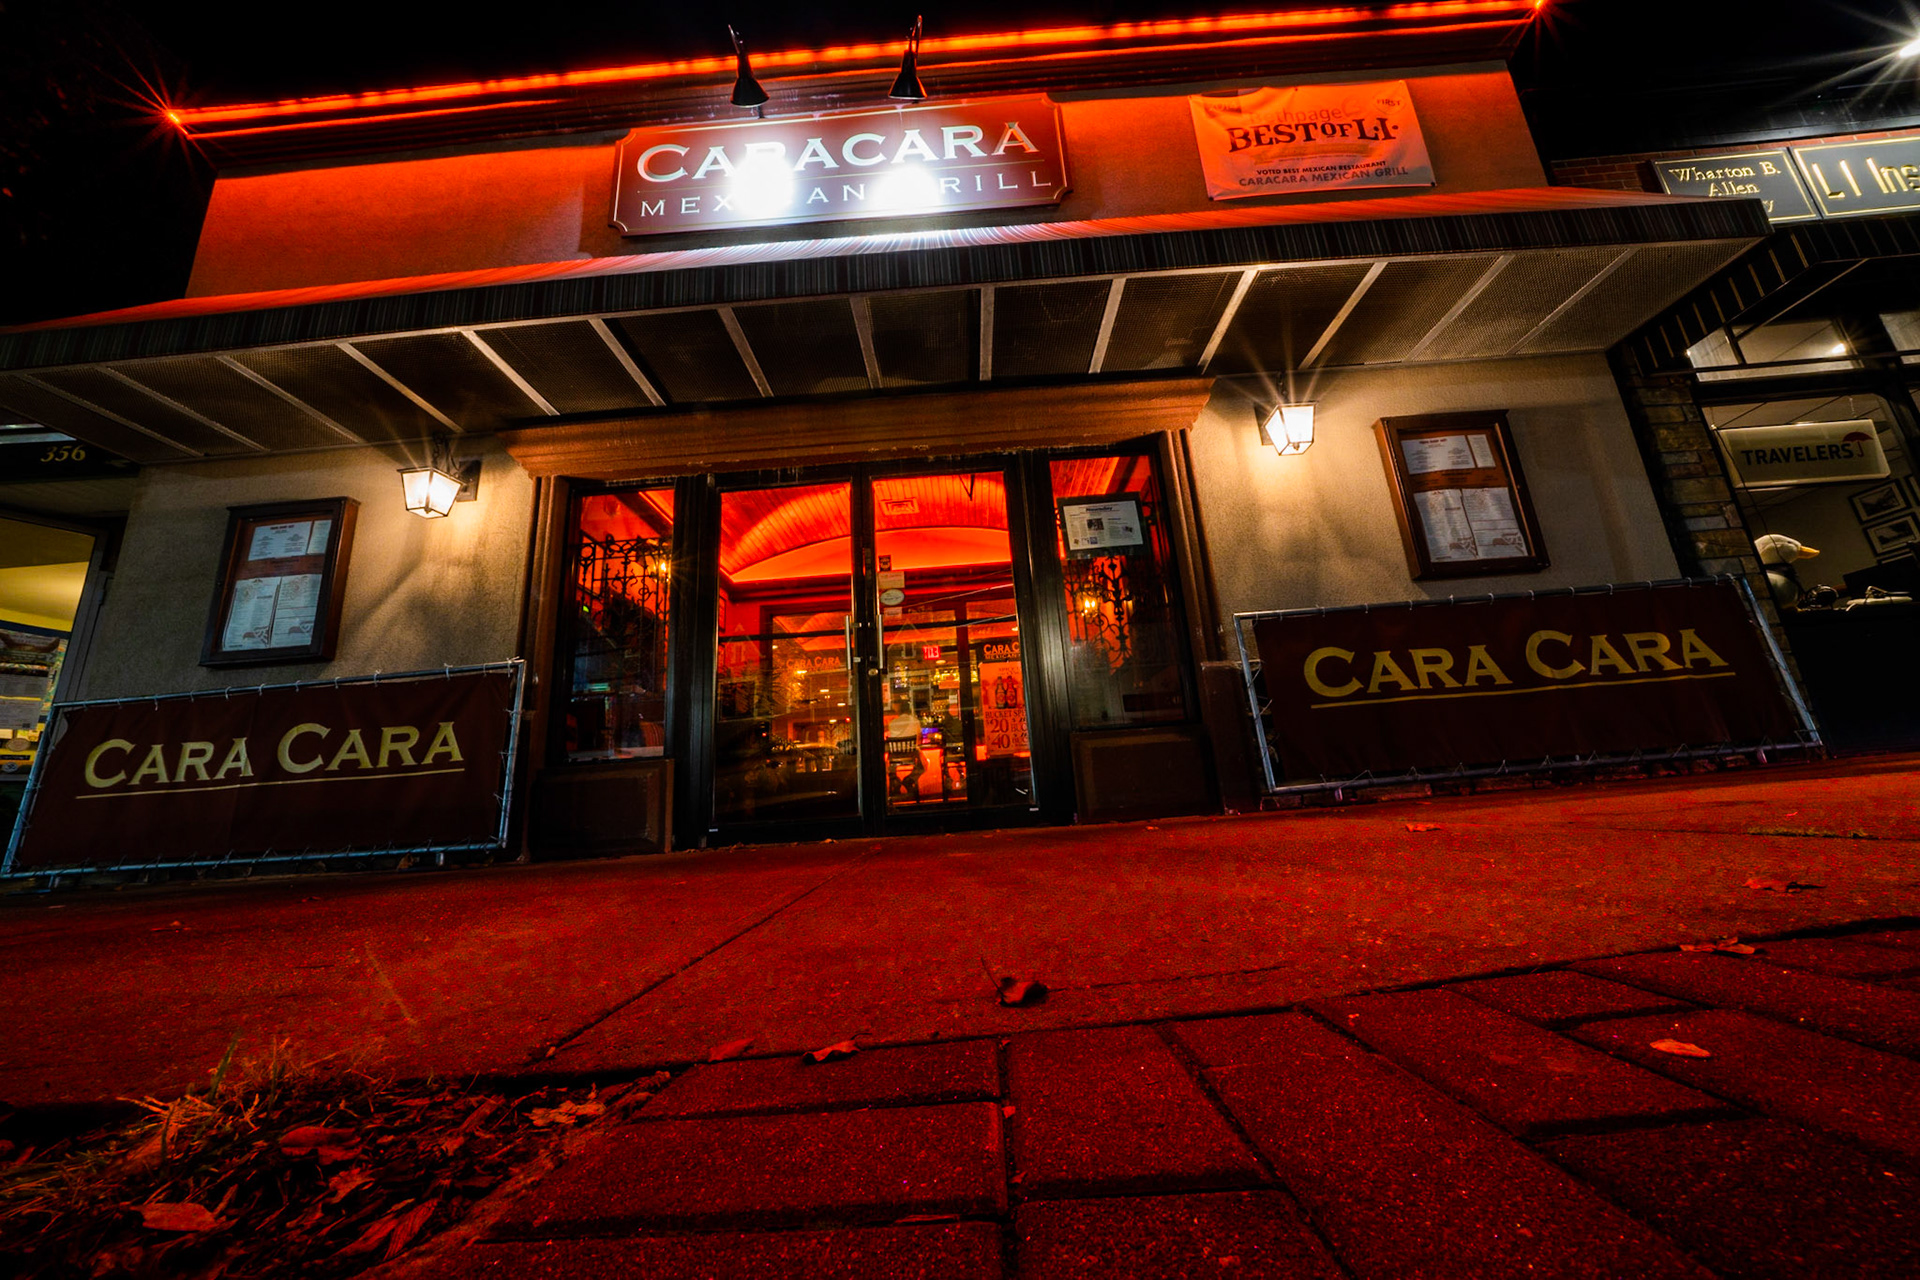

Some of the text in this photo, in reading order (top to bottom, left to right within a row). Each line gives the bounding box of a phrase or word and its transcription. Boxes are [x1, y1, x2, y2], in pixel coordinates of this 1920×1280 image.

[1227, 122, 1318, 153] BEST
[1320, 122, 1353, 138] OF
[1239, 166, 1408, 187] CARACARA MEXICAN GRILL
[1302, 165, 1337, 173] MEXICAN
[1338, 160, 1387, 171] RESTAURANT
[1668, 161, 1782, 182] Wharton B.
[640, 170, 1052, 218] MEXAN RILL
[1709, 182, 1760, 198] Allen
[40, 444, 87, 463] 356
[1741, 442, 1854, 466] TRAVELERS
[983, 643, 1011, 656] CARA
[1303, 628, 1729, 698] CARA CARA
[85, 721, 464, 788] CARA CARA
